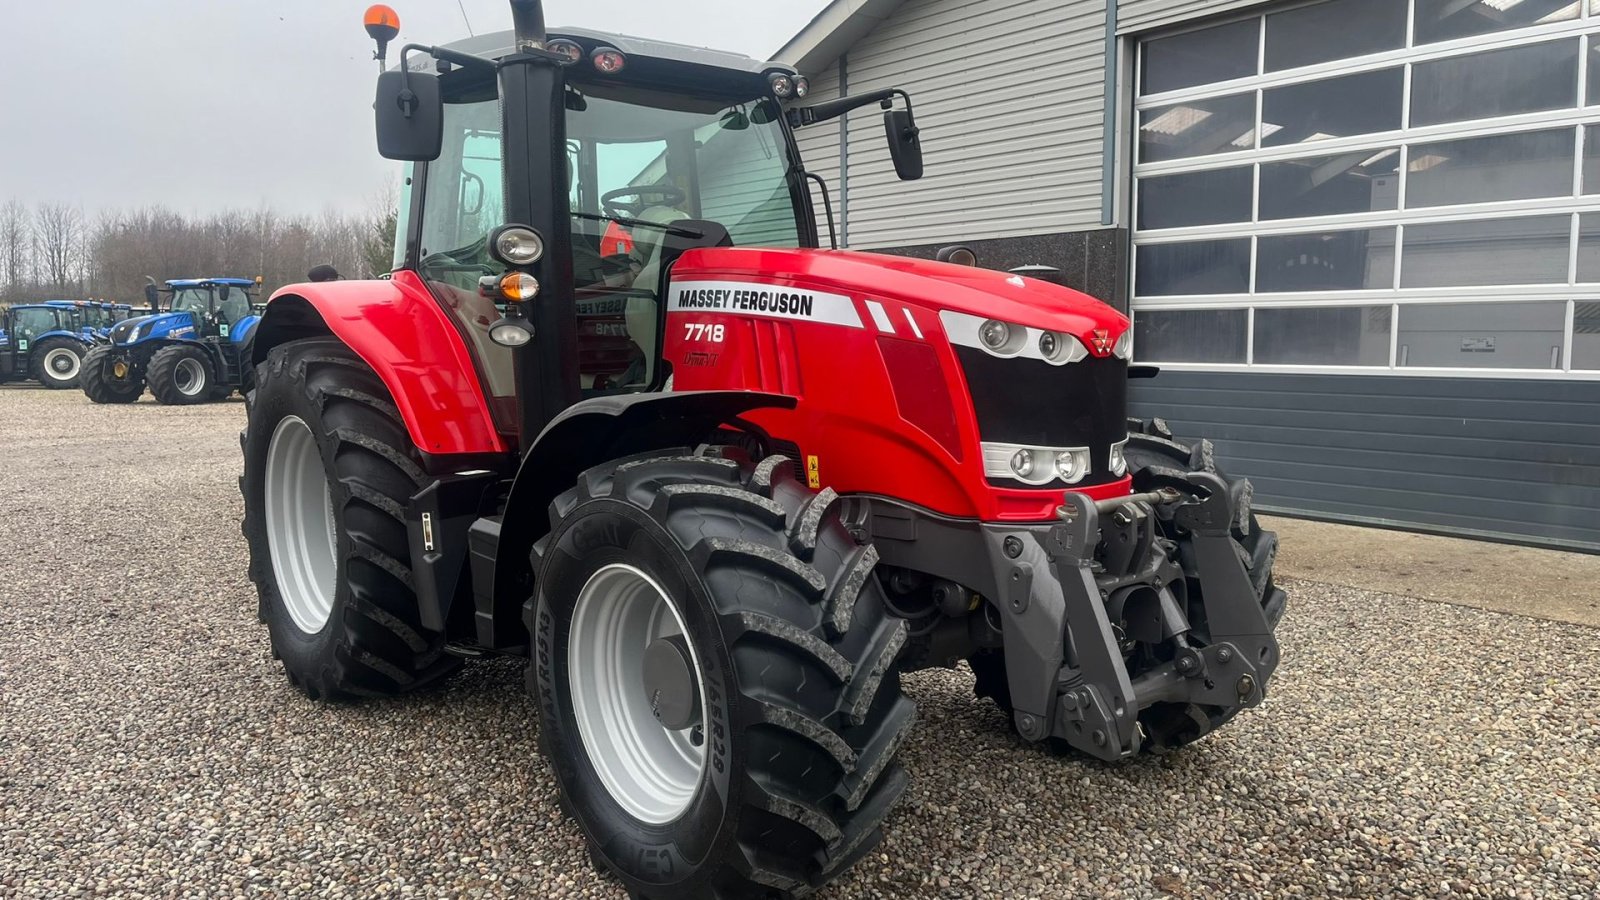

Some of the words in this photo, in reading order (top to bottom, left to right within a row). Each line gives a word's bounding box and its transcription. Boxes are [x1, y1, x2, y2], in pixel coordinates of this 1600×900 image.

[678, 289, 731, 308] MASSEY
[732, 290, 814, 316] FERGUSON
[684, 323, 725, 343] 7718
